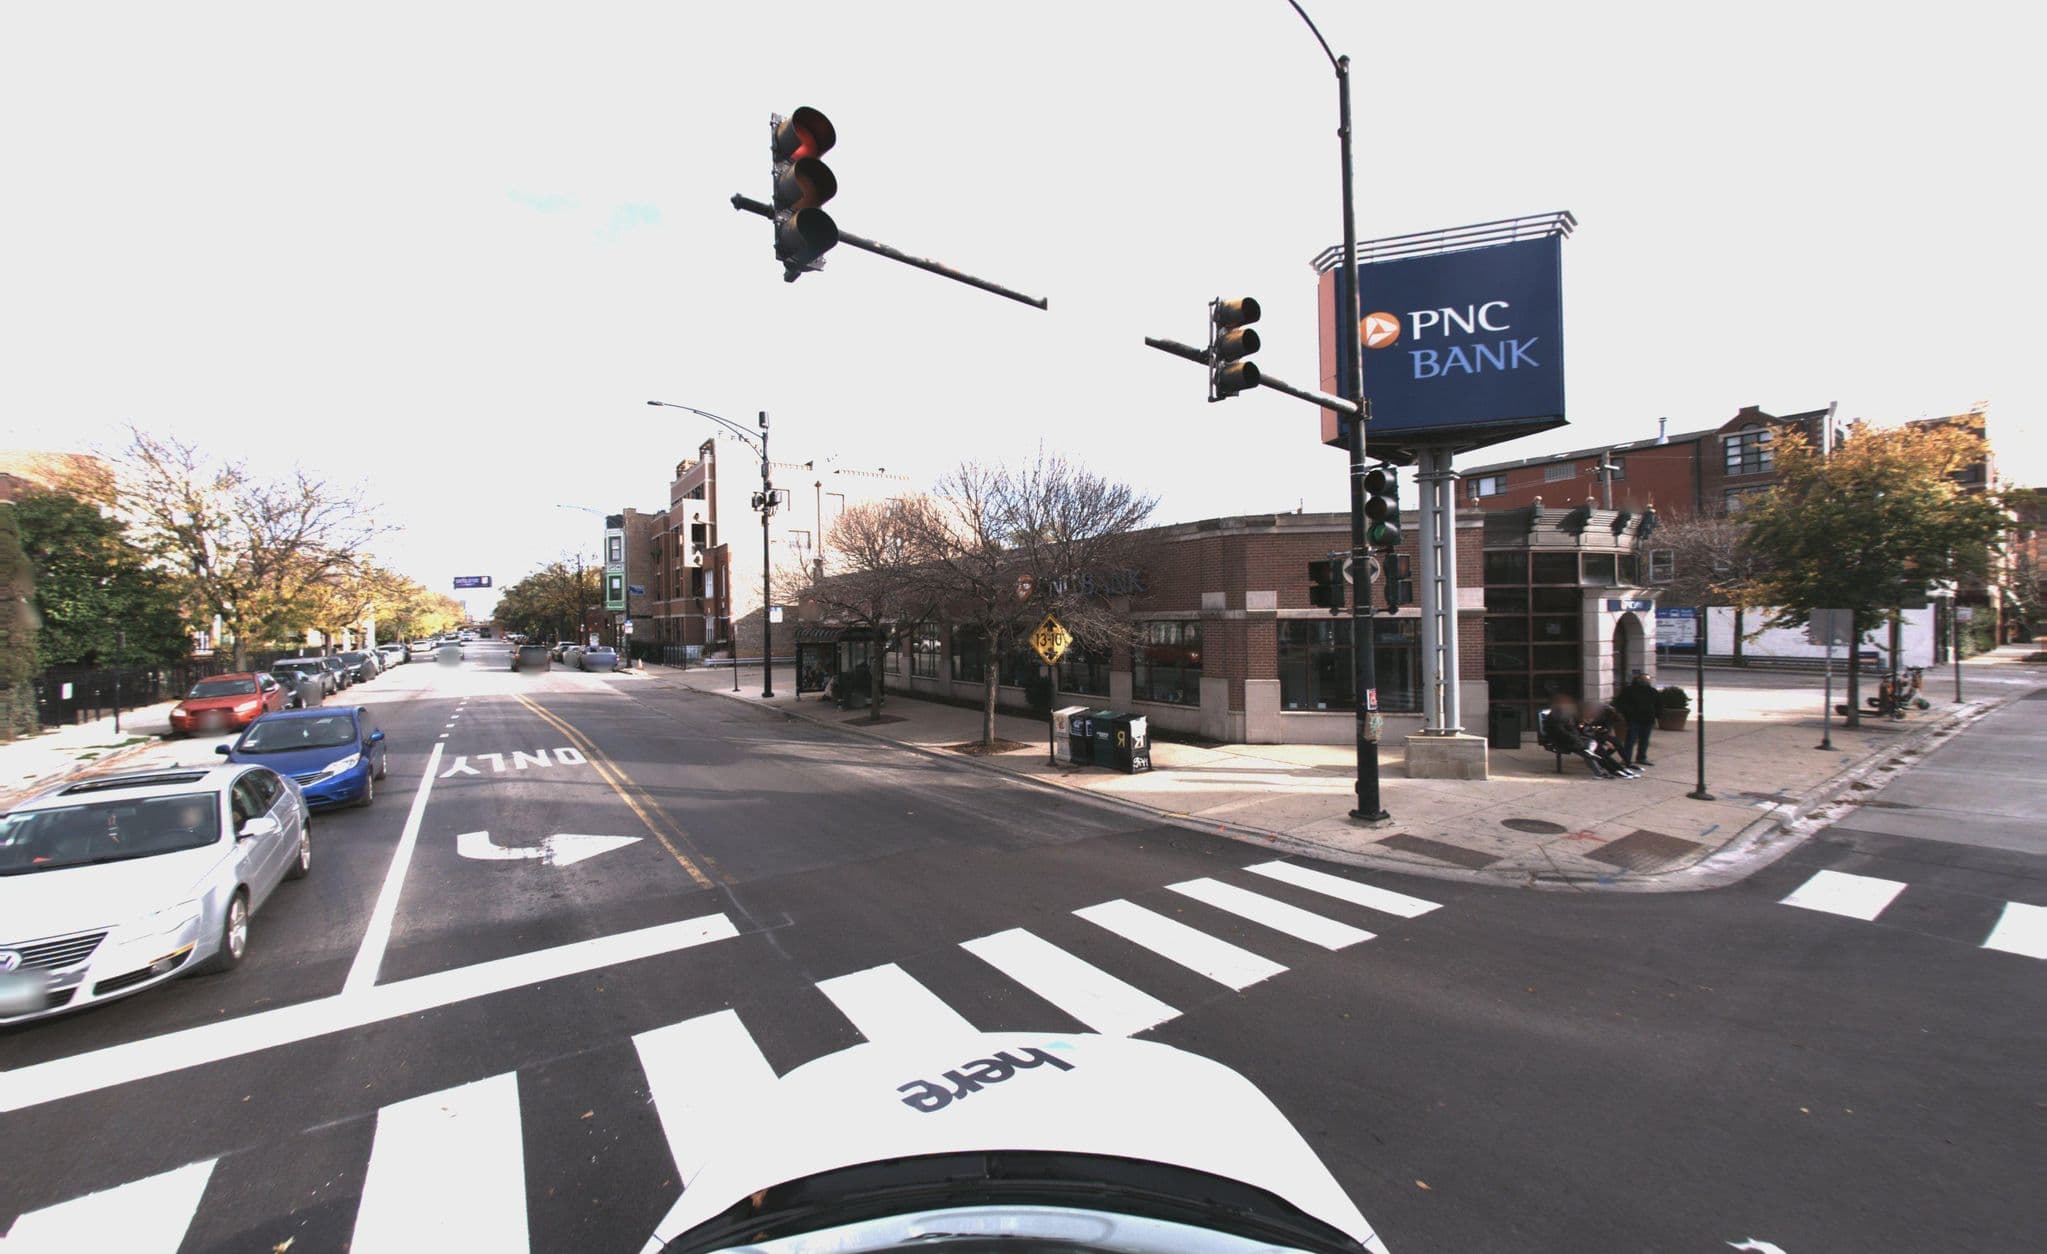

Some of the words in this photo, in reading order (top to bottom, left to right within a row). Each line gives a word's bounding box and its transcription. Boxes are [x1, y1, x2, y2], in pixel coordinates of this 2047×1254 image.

[1407, 301, 1510, 340] PNC
[1407, 336, 1540, 379] BANK
[439, 747, 587, 778] ONLY
[896, 1047, 1076, 1113] here
